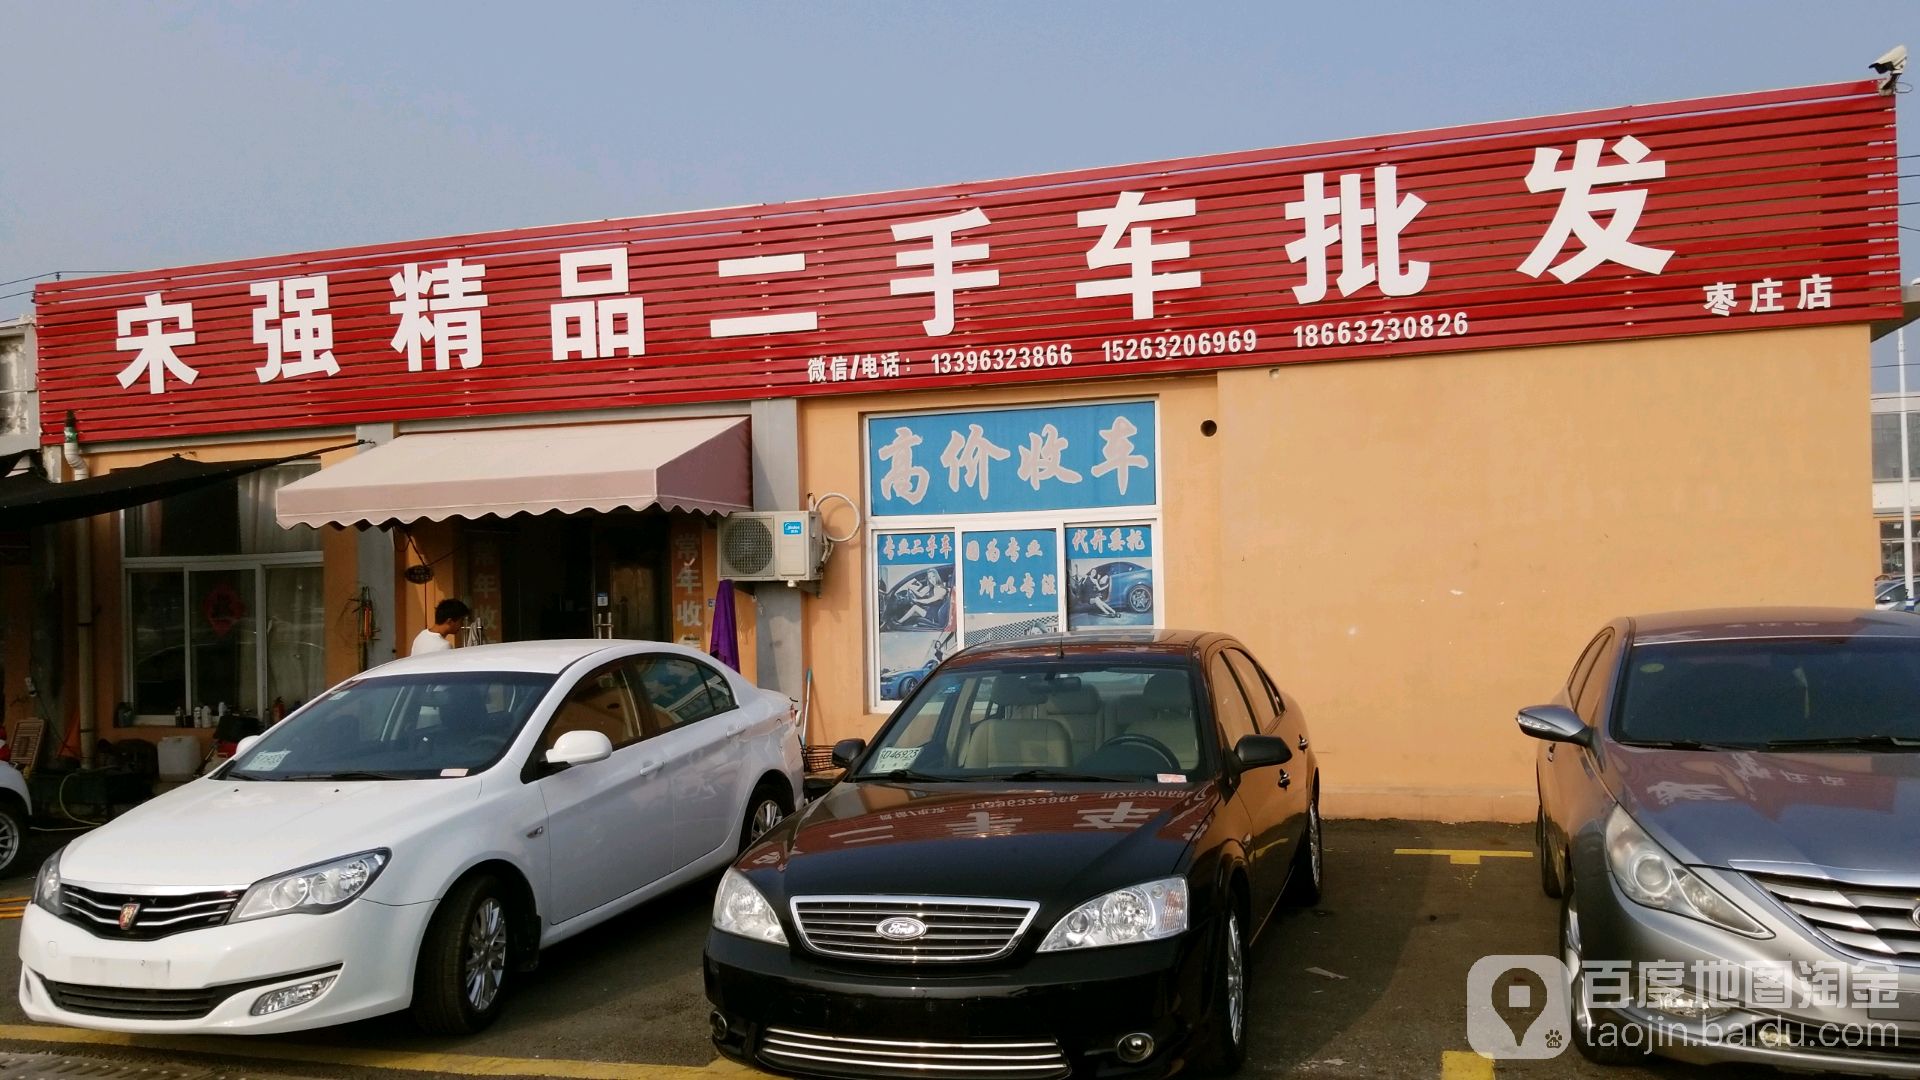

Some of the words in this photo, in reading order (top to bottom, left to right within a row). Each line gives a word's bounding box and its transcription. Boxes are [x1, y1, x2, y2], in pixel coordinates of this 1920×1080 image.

[115, 135, 1674, 395] 宋强精品二手车批发
[1702, 273, 1833, 317] 枣庄店
[931, 343, 1073, 374] 13396323866
[1101, 329, 1258, 362] 15263206969
[1293, 311, 1469, 348] 18663230826
[878, 415, 1150, 505] 高价收车
[883, 534, 953, 561] 专业二手车
[888, 922, 916, 935] Ford
